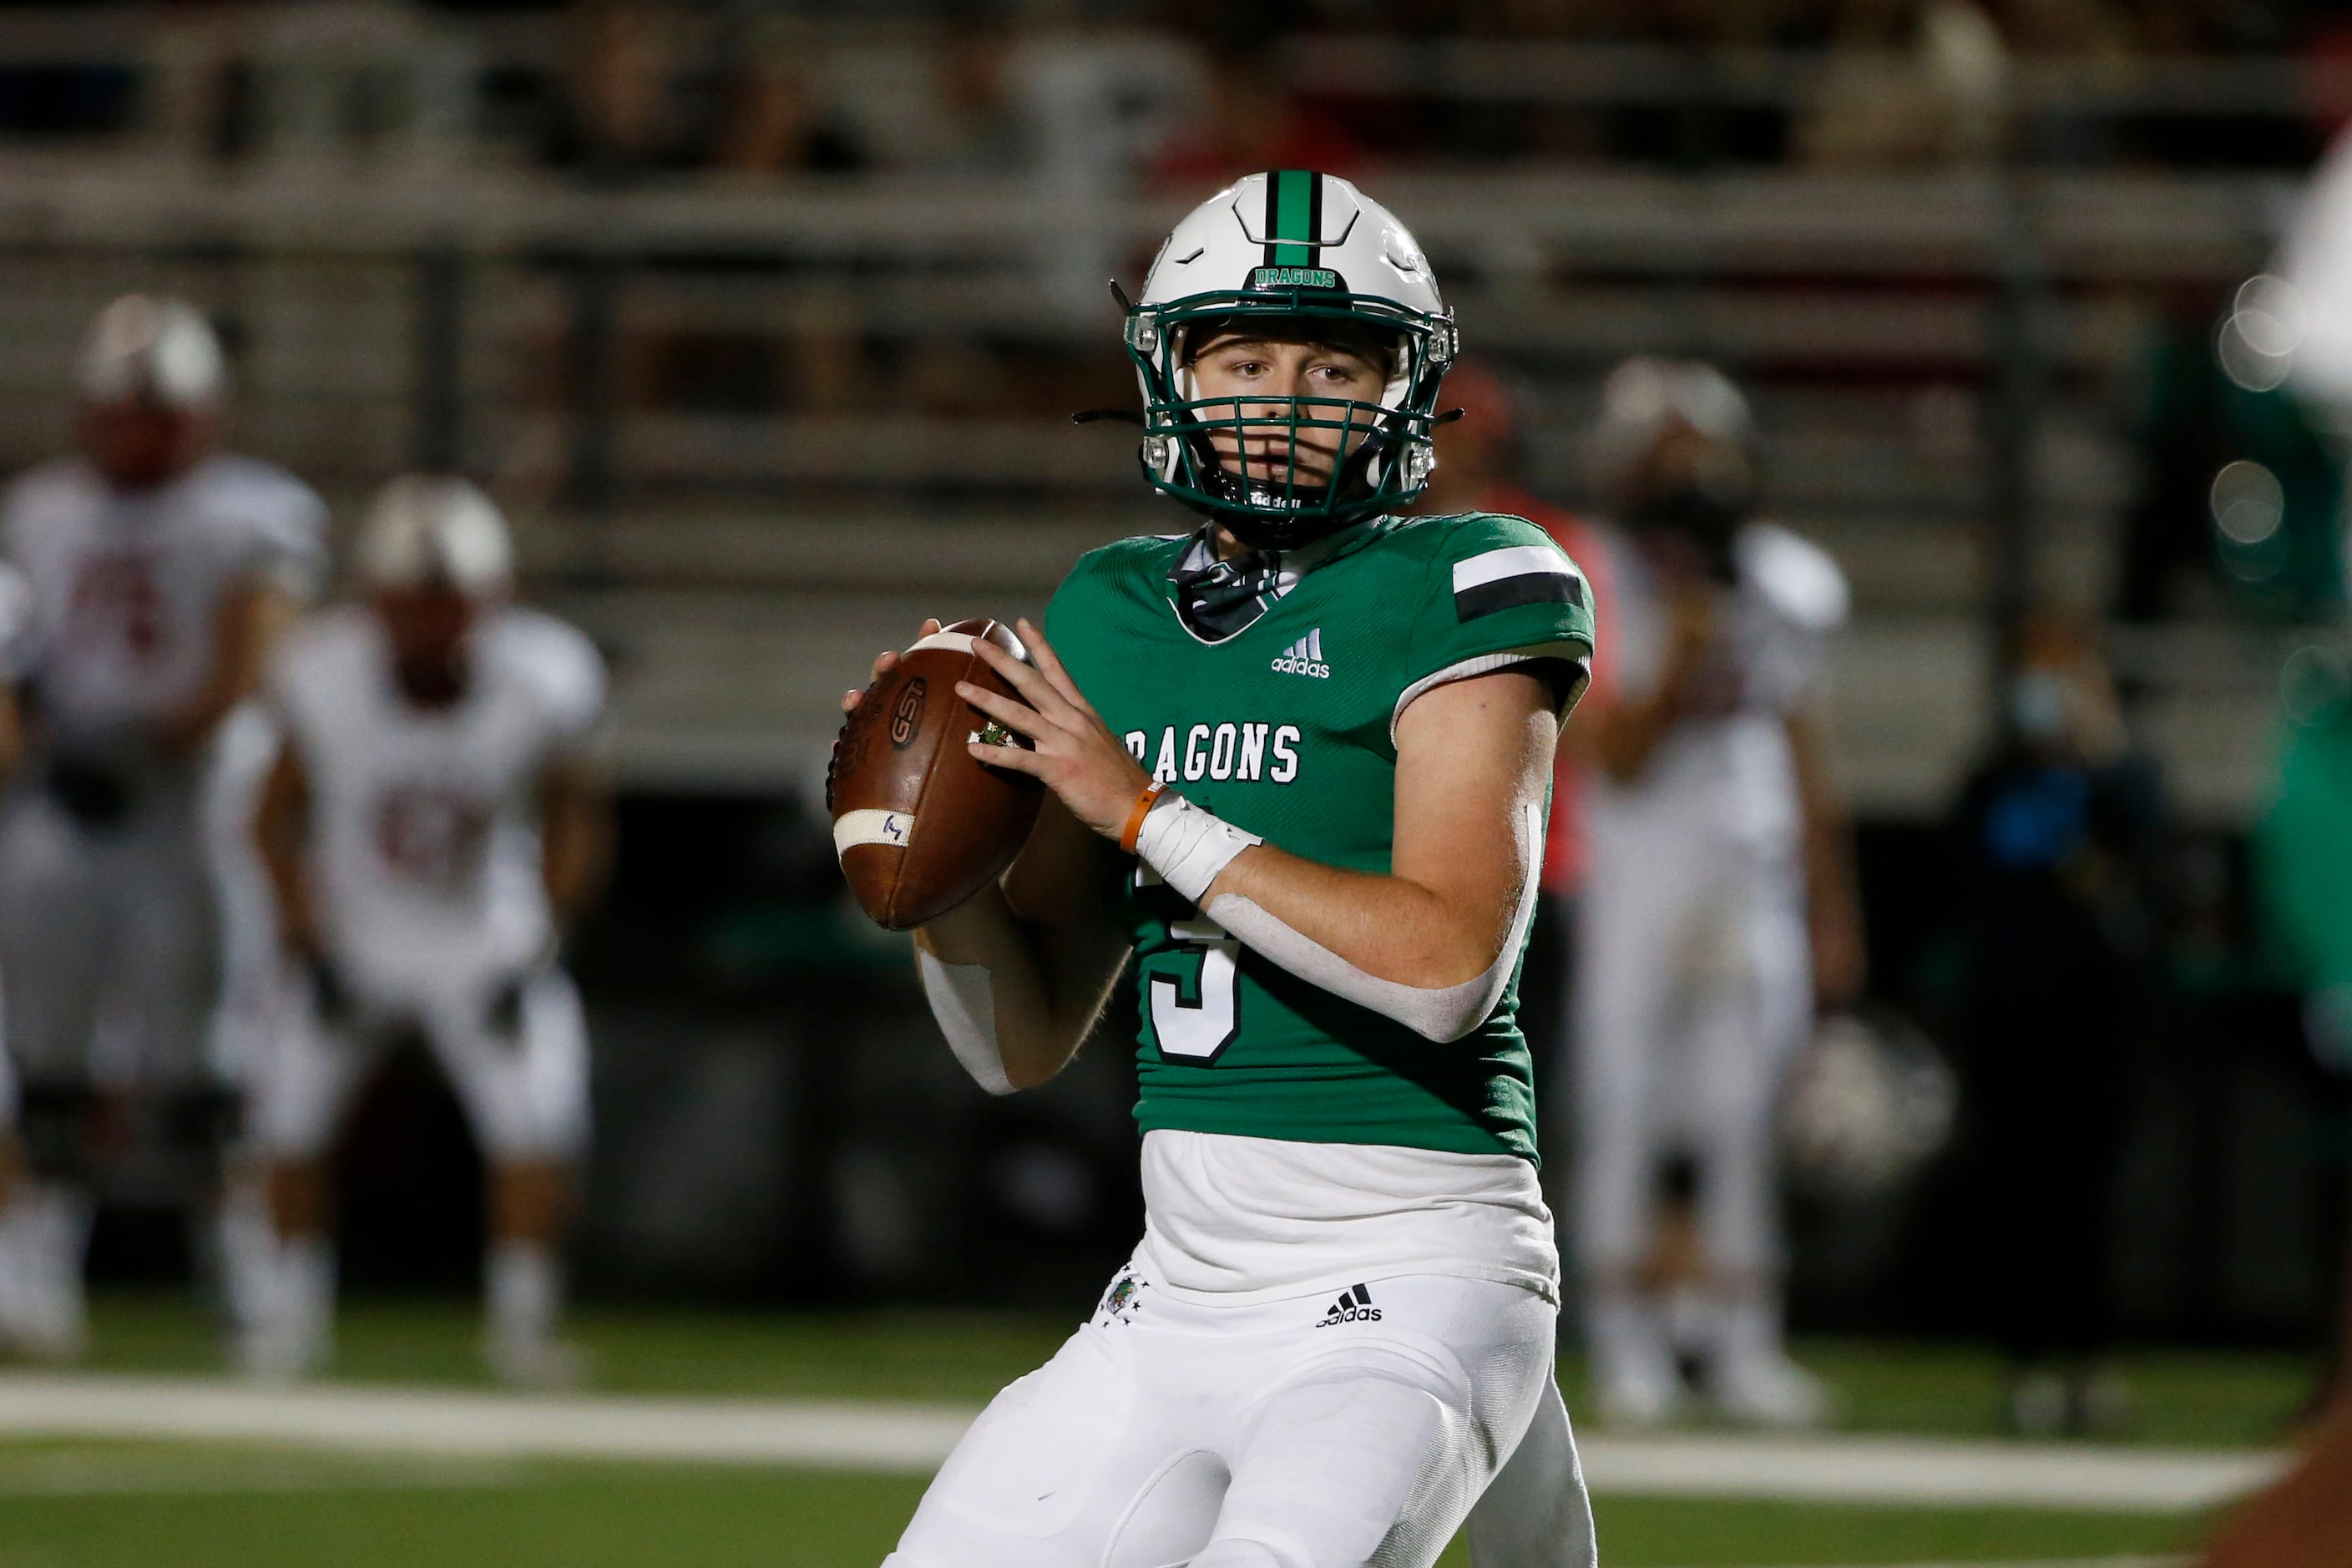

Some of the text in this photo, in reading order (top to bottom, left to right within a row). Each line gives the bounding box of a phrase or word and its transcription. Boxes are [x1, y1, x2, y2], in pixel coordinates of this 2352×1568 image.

[1255, 268, 1335, 288] DRAGONS
[1271, 656, 1329, 679] adidas
[892, 680, 923, 743] GST
[1125, 722, 1301, 783] RAGONS
[1316, 1306, 1382, 1328] adidas
